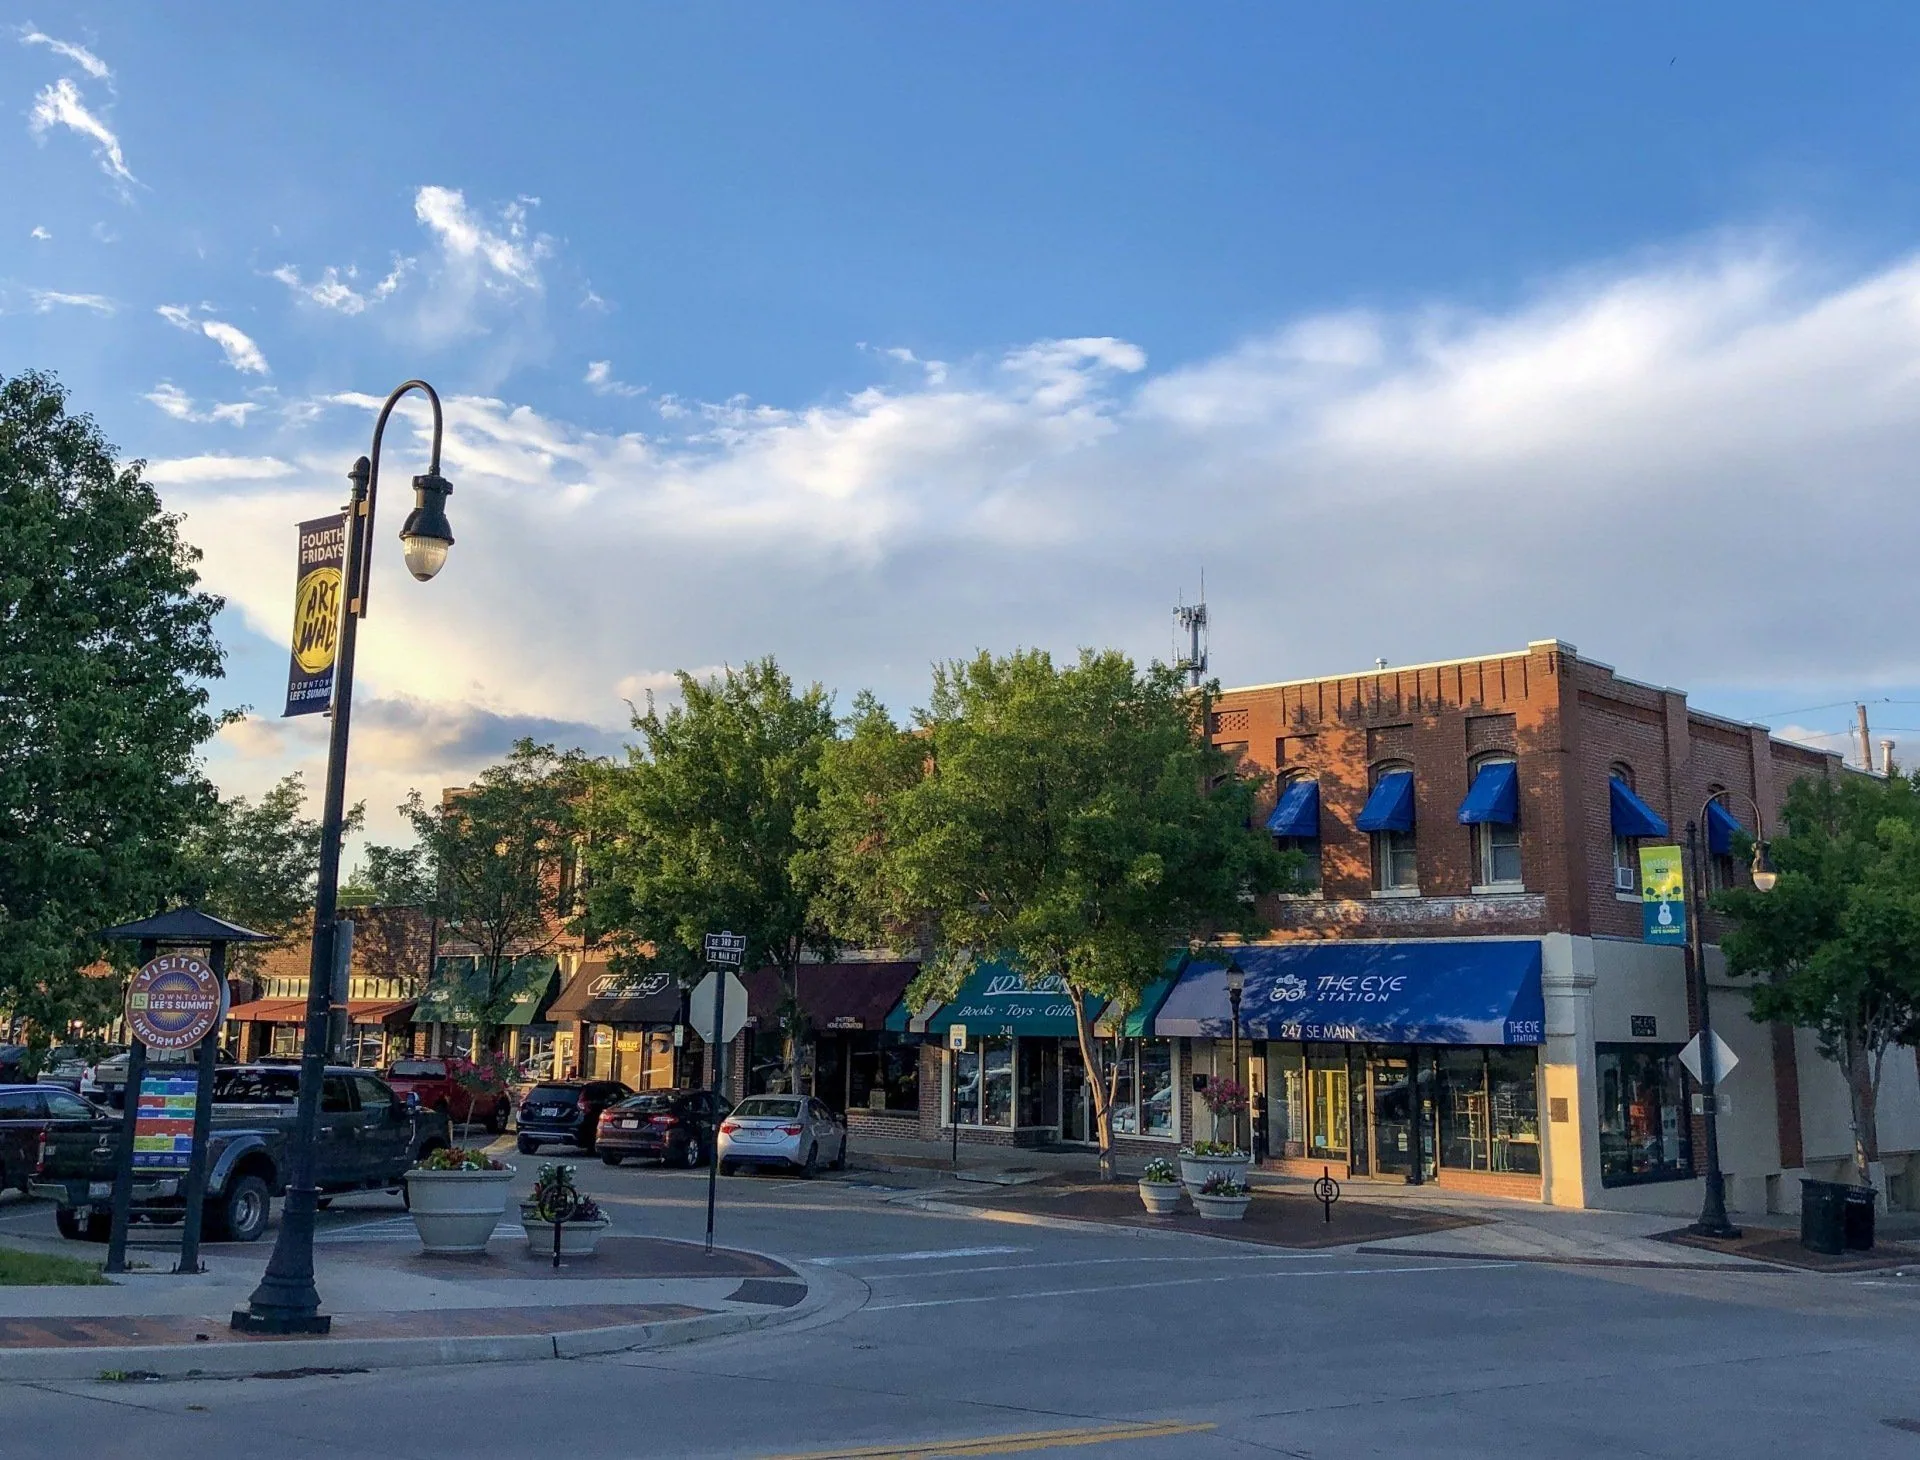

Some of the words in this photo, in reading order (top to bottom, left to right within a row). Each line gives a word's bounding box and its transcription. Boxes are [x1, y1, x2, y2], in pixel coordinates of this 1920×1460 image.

[301, 527, 344, 550] FOURTH
[301, 543, 344, 565] FRIDAYS
[306, 580, 339, 619] ART
[290, 690, 306, 701] LEE'S
[711, 938, 719, 946] SE
[139, 957, 210, 983] VISITOR
[1316, 976, 1358, 991] THE
[1360, 976, 1408, 991] EYE
[150, 993, 215, 1001] DOWNTOWN
[1317, 992, 1390, 1002] STATION
[149, 1001, 173, 1010] LEE'S
[174, 1001, 214, 1010] SUMMIT
[958, 1004, 996, 1017] Books
[1005, 1003, 1035, 1018] Toys
[1044, 1004, 1076, 1017] Gifts
[134, 1018, 209, 1046] INFORMATION
[1000, 1024, 1013, 1035] 241
[1281, 1024, 1302, 1038] 247
[1306, 1025, 1320, 1038] SE
[1322, 1025, 1356, 1039] MAIN
[1508, 1020, 1524, 1033] THE
[1524, 1020, 1540, 1033] EYE
[1513, 1034, 1538, 1042] STATION
[1322, 1185, 1332, 1195] LS
